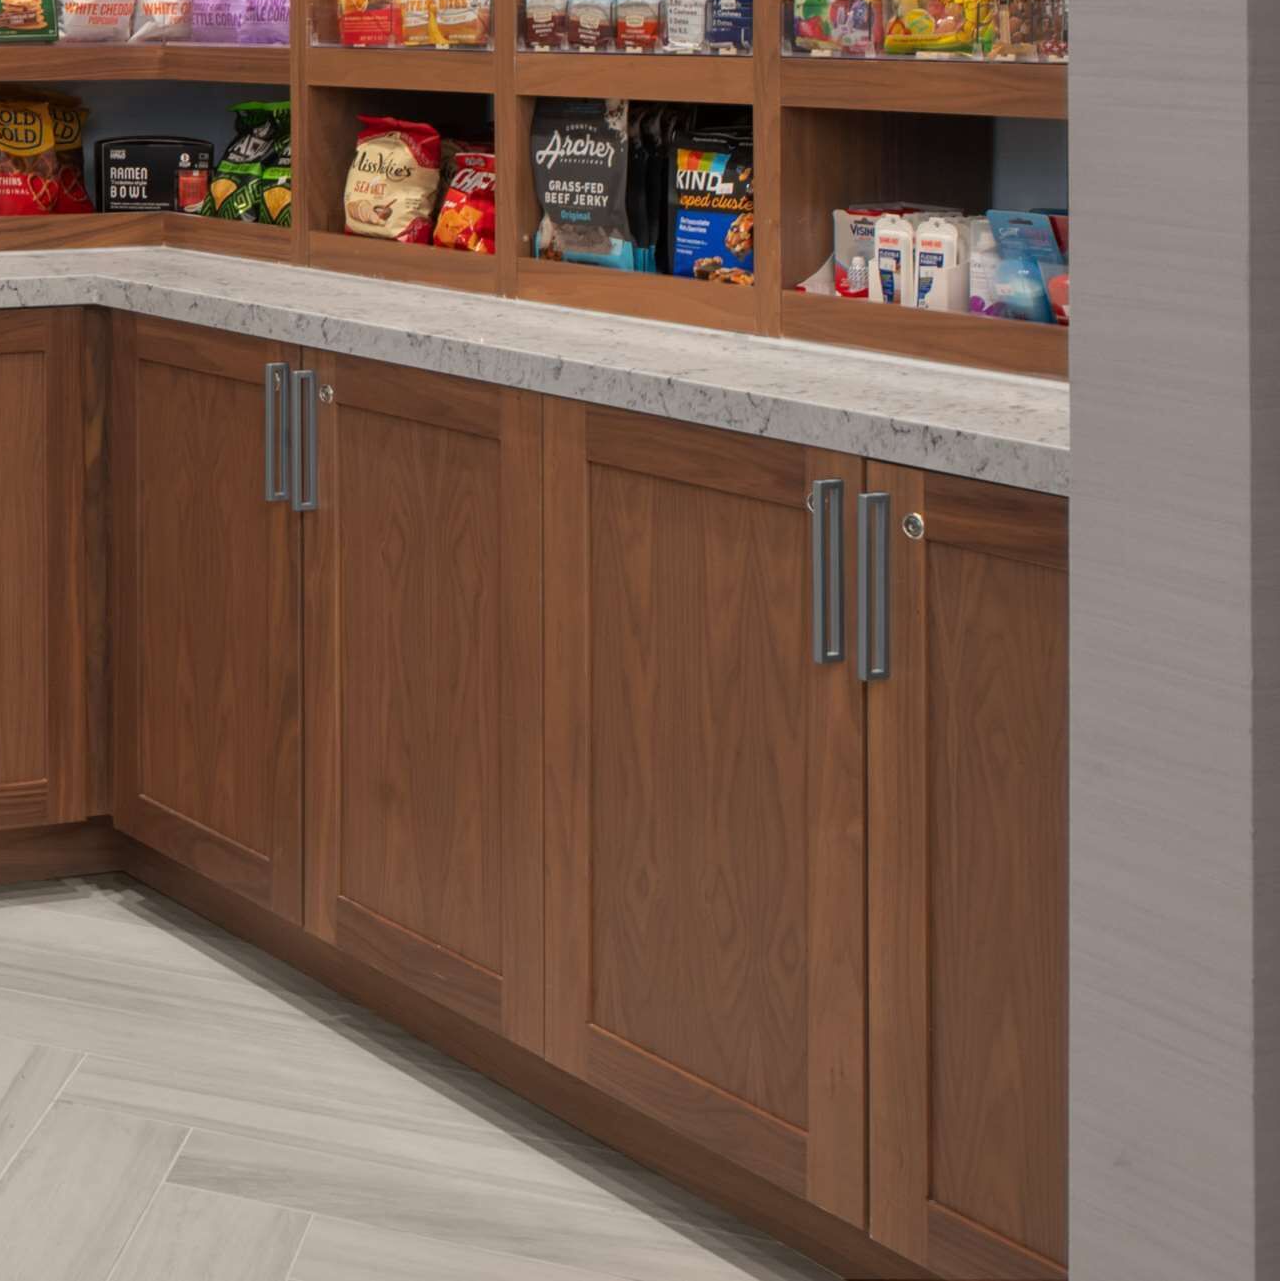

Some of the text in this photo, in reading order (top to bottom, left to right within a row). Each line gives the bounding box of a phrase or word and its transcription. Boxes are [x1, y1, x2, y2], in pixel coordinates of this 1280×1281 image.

[65, 2, 133, 16] WHITE CHEDD
[142, 2, 178, 17] WHITE
[193, 12, 214, 26] ETTLE
[566, 124, 598, 133] COUNTRY
[536, 130, 615, 169] Archer
[110, 166, 148, 180] RAMEN
[676, 168, 722, 192] KIND
[110, 185, 147, 199] BOWL
[548, 179, 604, 194] GRASS-FED
[544, 192, 609, 207] BEEF JERKY
[560, 209, 591, 221] Original
[850, 224, 875, 237] VISIN
